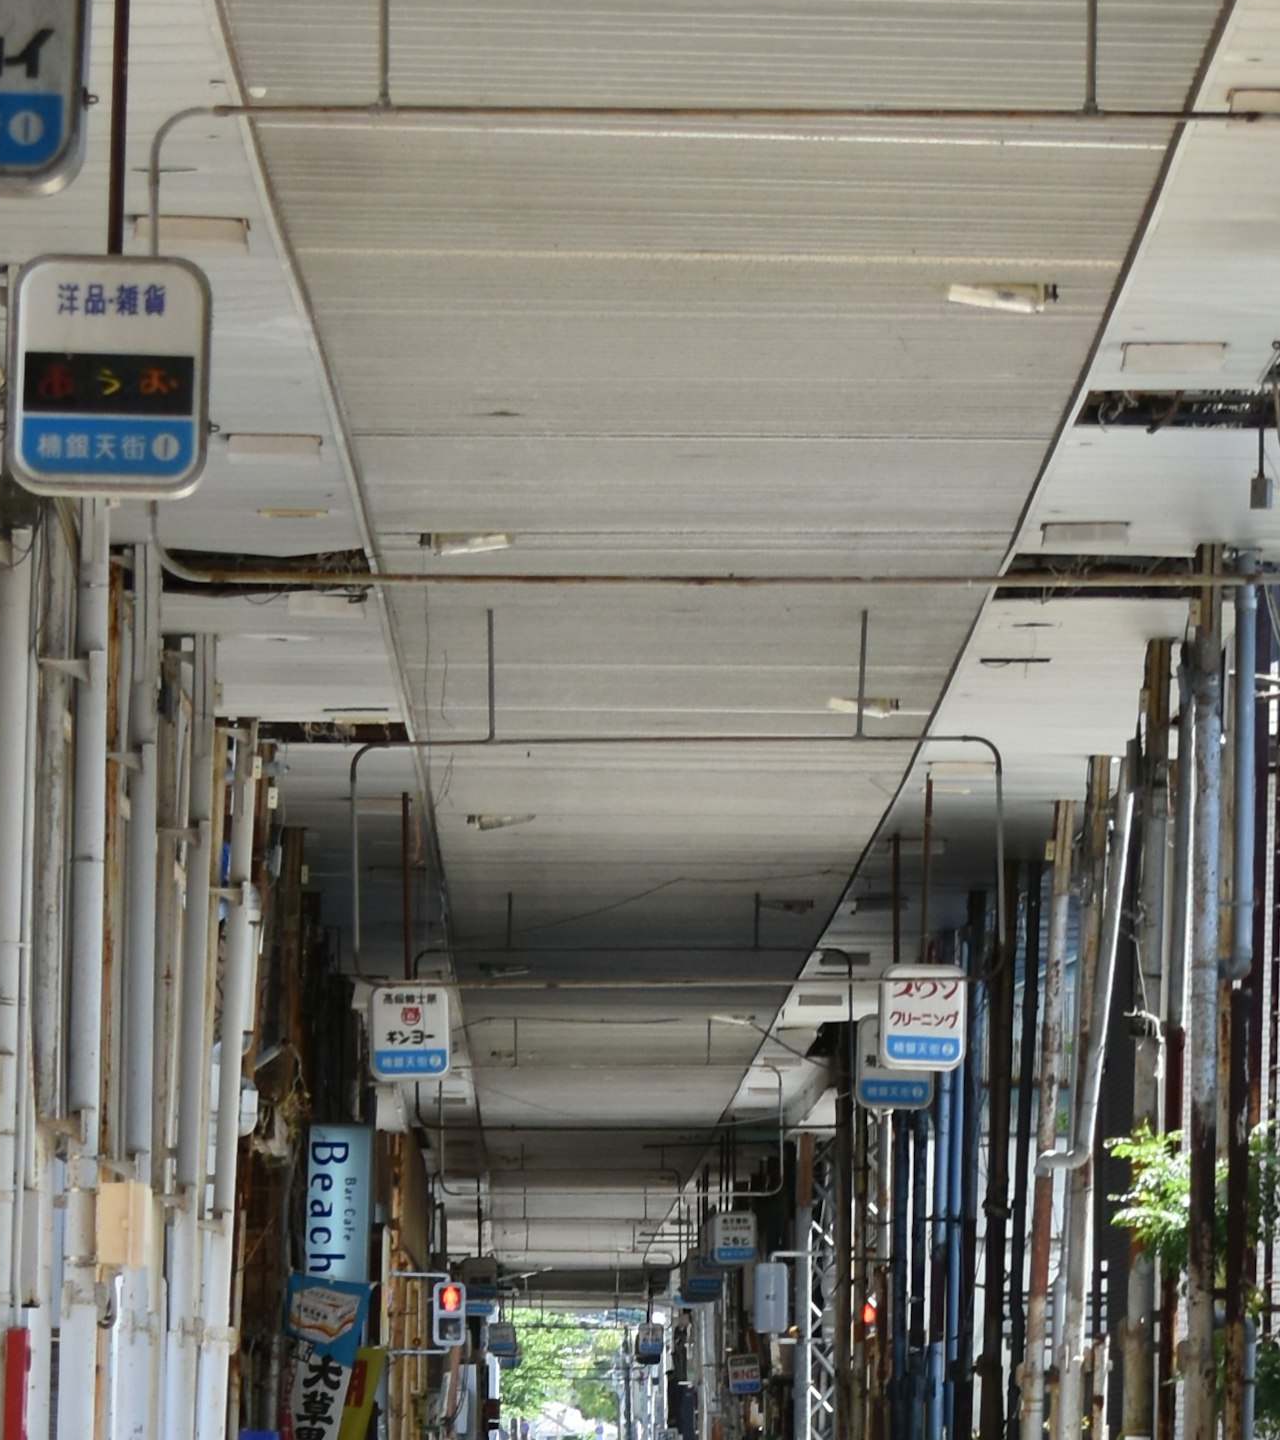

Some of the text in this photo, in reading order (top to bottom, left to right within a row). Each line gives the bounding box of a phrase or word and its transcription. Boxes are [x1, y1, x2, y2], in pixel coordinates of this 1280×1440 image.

[57, 284, 166, 317] 洋品・雑貨
[889, 1011, 959, 1029] クリーニング
[309, 1141, 350, 1273] Beach
[343, 1177, 357, 1242] Bar Cafe
